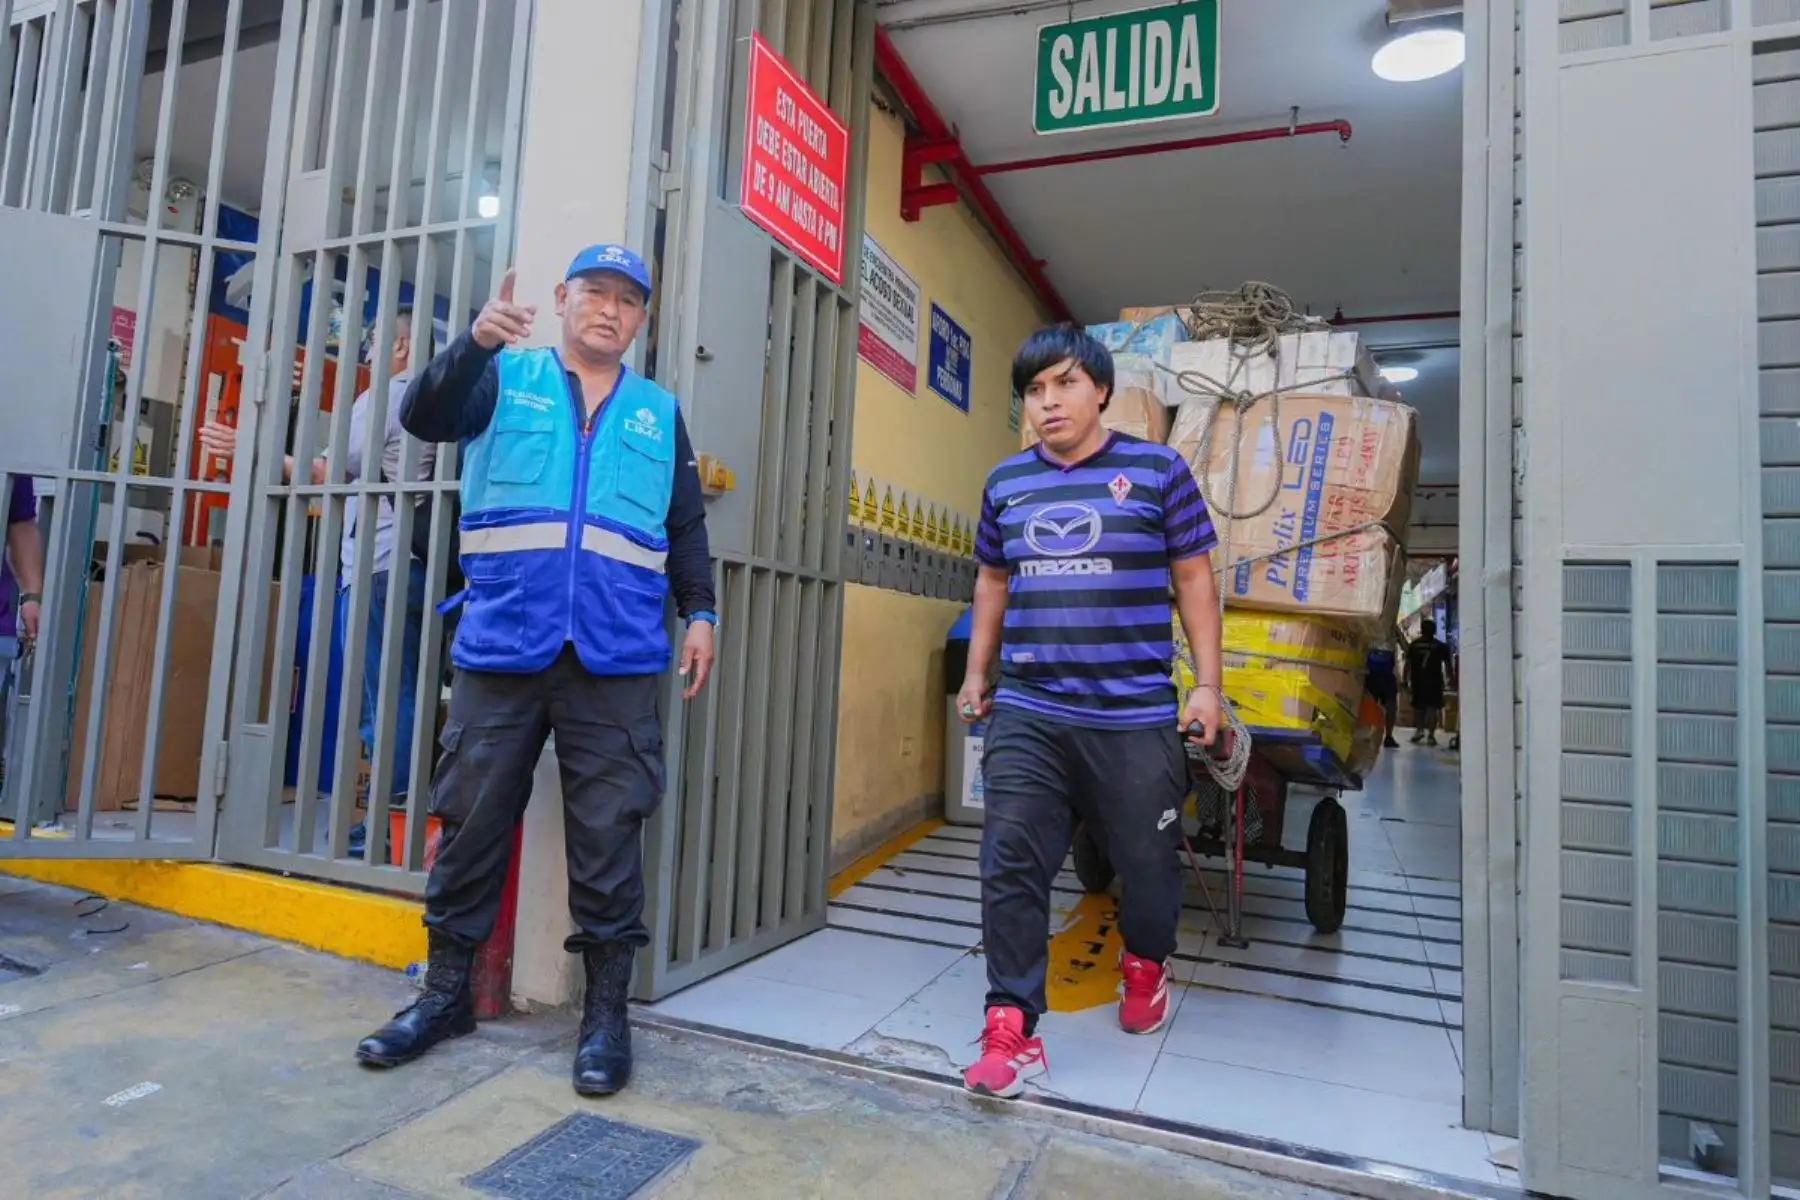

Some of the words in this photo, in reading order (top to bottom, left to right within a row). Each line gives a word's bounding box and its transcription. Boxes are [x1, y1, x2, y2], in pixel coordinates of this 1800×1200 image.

[1049, 14, 1202, 119] SALIDA
[757, 114, 780, 161] DEBE
[782, 136, 807, 185] ESTAR
[808, 163, 839, 213] ABIERTA
[776, 86, 796, 131] ESTA
[798, 107, 828, 160] PUERTA
[753, 160, 767, 197] DE
[768, 172, 775, 203] 9
[775, 180, 791, 216] AM
[791, 191, 817, 238] HASTA
[824, 220, 837, 253] PM
[1282, 417, 1312, 489] LED
